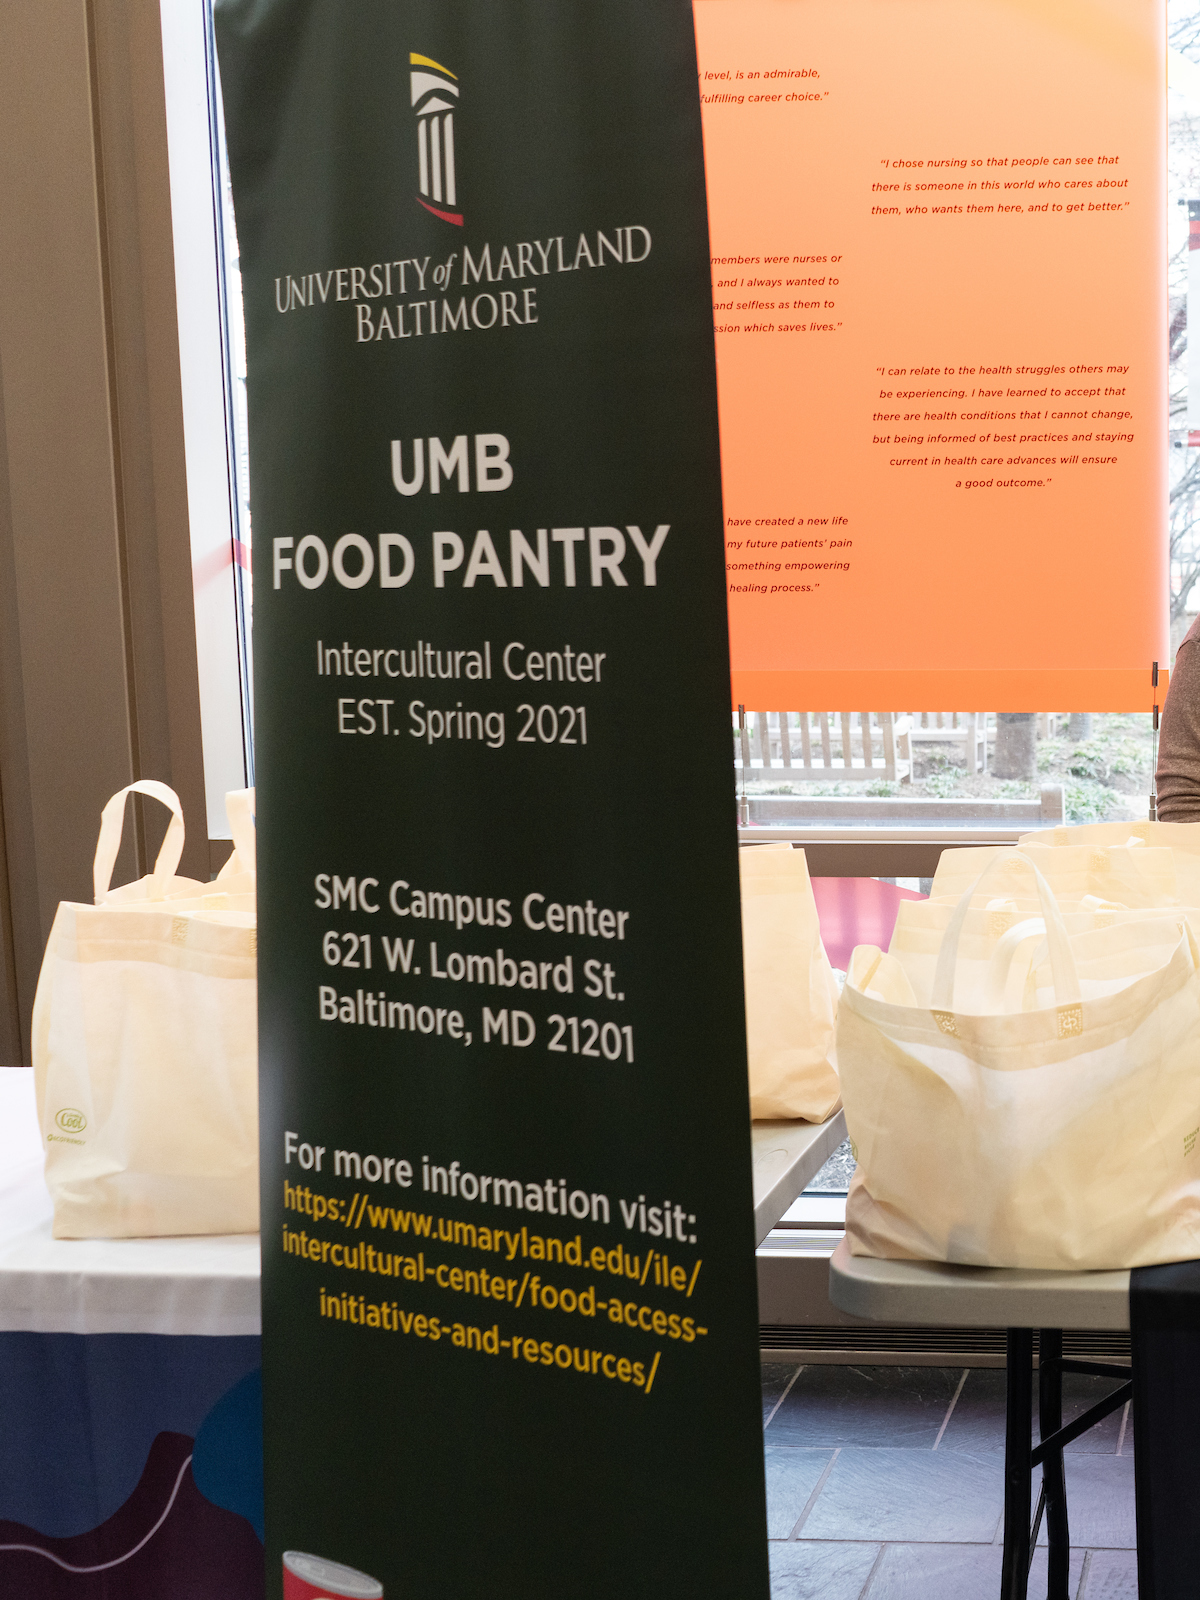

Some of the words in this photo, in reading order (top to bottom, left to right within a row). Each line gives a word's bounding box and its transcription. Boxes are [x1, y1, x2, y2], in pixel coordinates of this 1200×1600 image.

[704, 70, 732, 82] level,
[763, 68, 821, 79] admirable,
[747, 94, 783, 103] career
[892, 158, 925, 169] chose
[926, 157, 968, 169] nursing
[986, 156, 1009, 167] that
[1010, 156, 1050, 168] people
[1097, 155, 1120, 165] that
[871, 182, 901, 192] there
[914, 182, 965, 192] someone
[980, 180, 1001, 190] this
[1003, 179, 1036, 190] world
[1063, 180, 1094, 189] cares
[1095, 178, 1129, 188] about
[871, 205, 902, 216] them,
[931, 204, 964, 214] wants
[966, 203, 995, 214] them
[996, 203, 1024, 214] here,
[763, 256, 790, 264] were
[792, 255, 828, 264] nurses
[275, 254, 431, 313] UNIVERSITY
[433, 252, 457, 291] of
[461, 225, 652, 286] MARYLAND
[746, 277, 783, 289] always
[785, 276, 826, 287] wanted
[735, 300, 776, 310] selfless
[793, 299, 821, 309] them
[355, 288, 539, 343] BALTIMORE
[743, 322, 775, 333] which
[777, 324, 807, 332] saves
[909, 366, 941, 376] relate
[978, 364, 1013, 375] health
[1015, 364, 1066, 376] struggles
[1068, 364, 1104, 374] others
[895, 388, 968, 400] experiencing.
[977, 388, 1004, 398] have
[1006, 387, 1048, 398] learned
[1064, 387, 1102, 398] accept
[872, 411, 901, 422] there
[923, 411, 958, 421] health
[960, 410, 1017, 421] conditions
[1050, 410, 1089, 420] cannot
[1090, 409, 1133, 421] change,
[893, 434, 925, 445] being
[926, 433, 977, 443] informed
[1018, 432, 1069, 444] practices
[1094, 431, 1135, 443] staying
[390, 433, 514, 497] UMB
[889, 456, 929, 467] current
[943, 455, 978, 466] health
[1006, 455, 1057, 465] advances
[1081, 456, 1118, 465] ensure
[754, 516, 796, 527] created
[745, 539, 778, 549] future
[272, 533, 415, 590] FOOD
[432, 524, 671, 589] PANTRY
[726, 561, 782, 572] something
[784, 560, 851, 572] empowering
[729, 583, 768, 594] healing
[316, 640, 492, 681] Intercultural
[503, 642, 606, 684] Center
[337, 698, 400, 736] EST.
[408, 701, 506, 749] Spring
[516, 704, 589, 745] 2021
[314, 873, 380, 913] SMC
[389, 880, 512, 930] Campus
[522, 893, 629, 941] Center
[322, 930, 372, 970] 621
[382, 937, 421, 975] W.
[430, 942, 574, 993] Lombard
[583, 959, 626, 1001] St.
[318, 986, 472, 1047] Baltimore,
[482, 1007, 536, 1048] MD
[547, 1014, 635, 1064] 21201
[61, 1112, 83, 1129] Cool
[284, 1131, 326, 1172] For
[334, 1148, 413, 1189] more
[422, 1155, 610, 1225] information
[620, 1195, 698, 1244] visit:
[284, 1180, 703, 1298] https://www.umaryland.edu/ile/
[282, 1224, 709, 1343] intercultural-center/food-access-
[320, 1288, 661, 1395] initiatives-and-resources/
